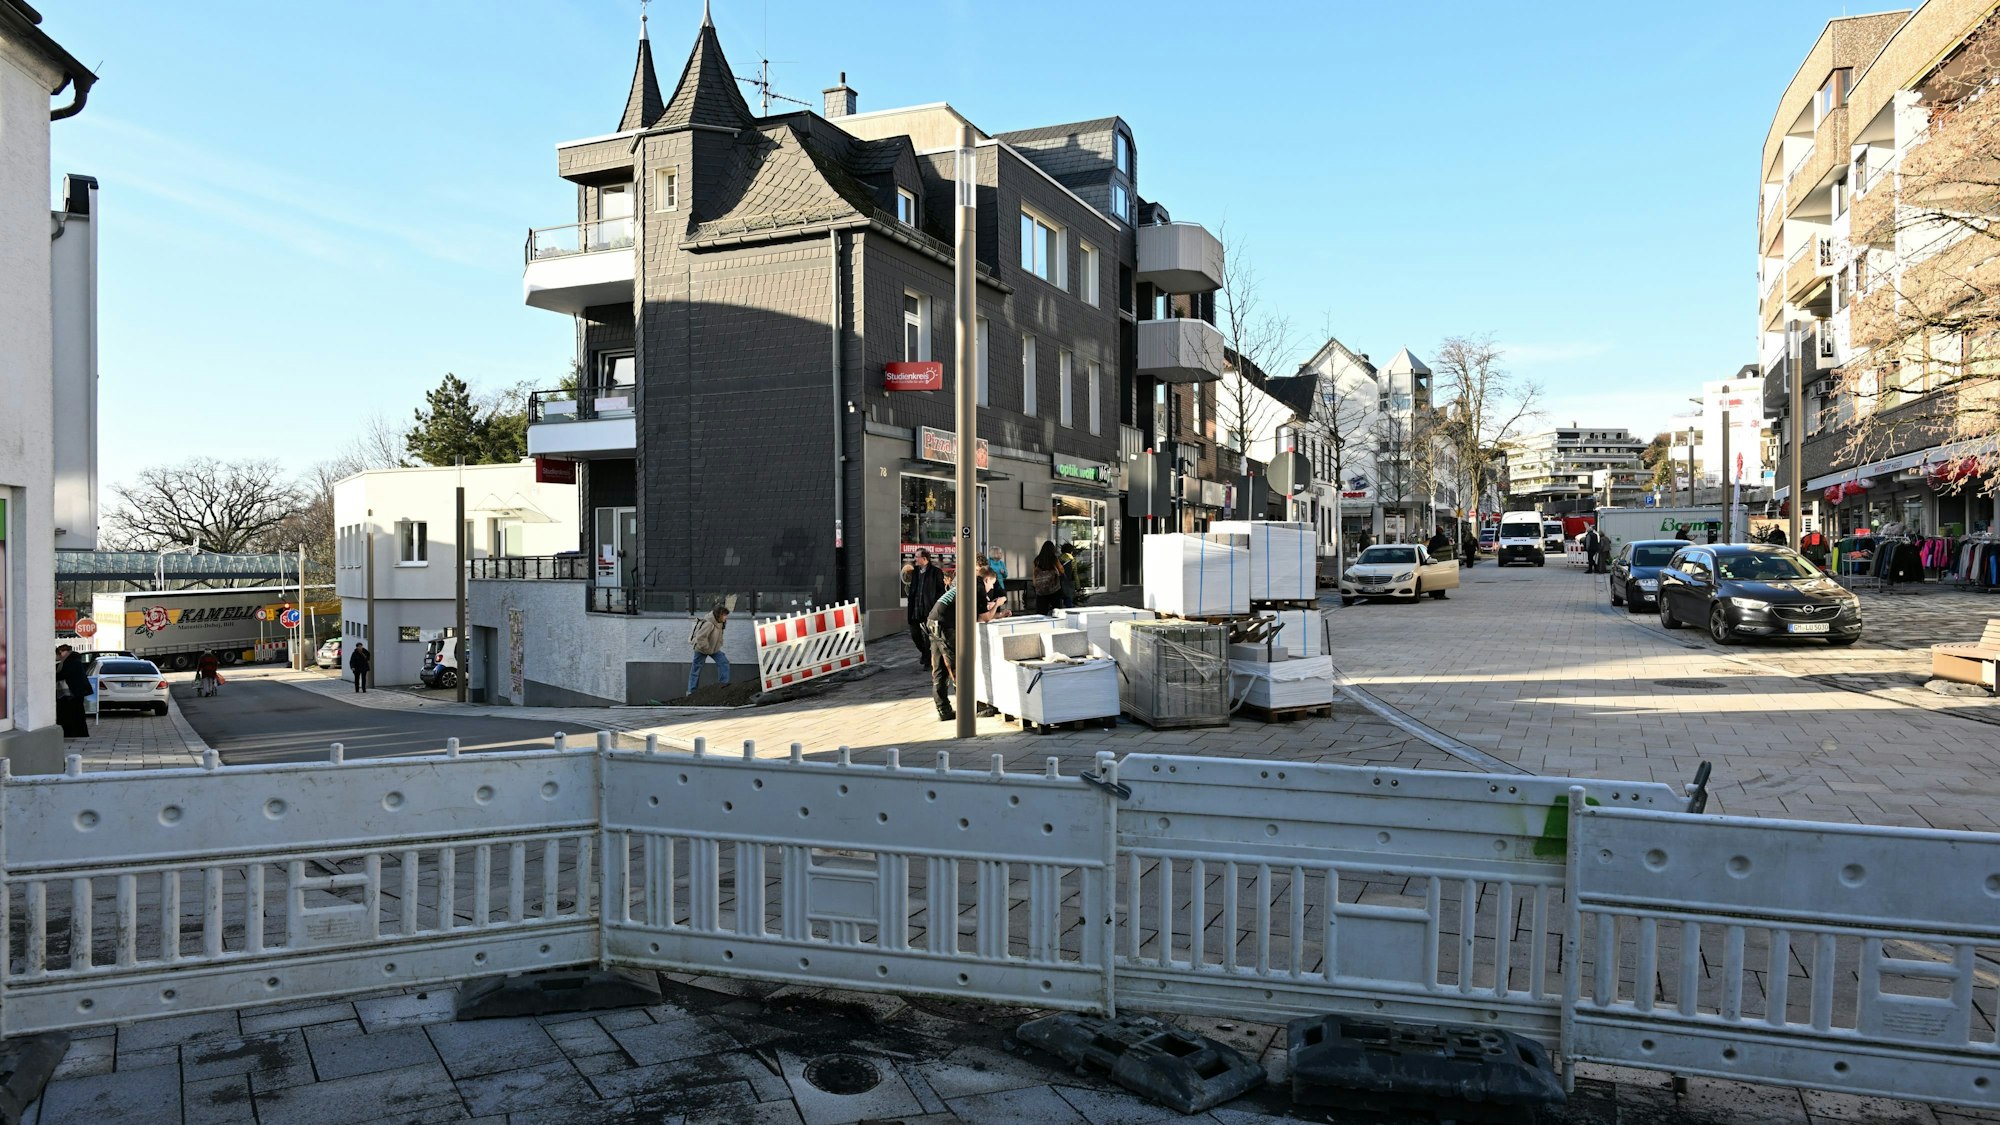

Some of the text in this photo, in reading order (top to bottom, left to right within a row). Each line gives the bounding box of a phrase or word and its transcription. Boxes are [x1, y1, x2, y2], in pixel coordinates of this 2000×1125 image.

[886, 371, 929, 380] Studienkreis
[924, 431, 952, 453] Pizza
[880, 467, 887, 477] 78
[1060, 463, 1078, 477] optik
[77, 623, 95, 633] STOP
